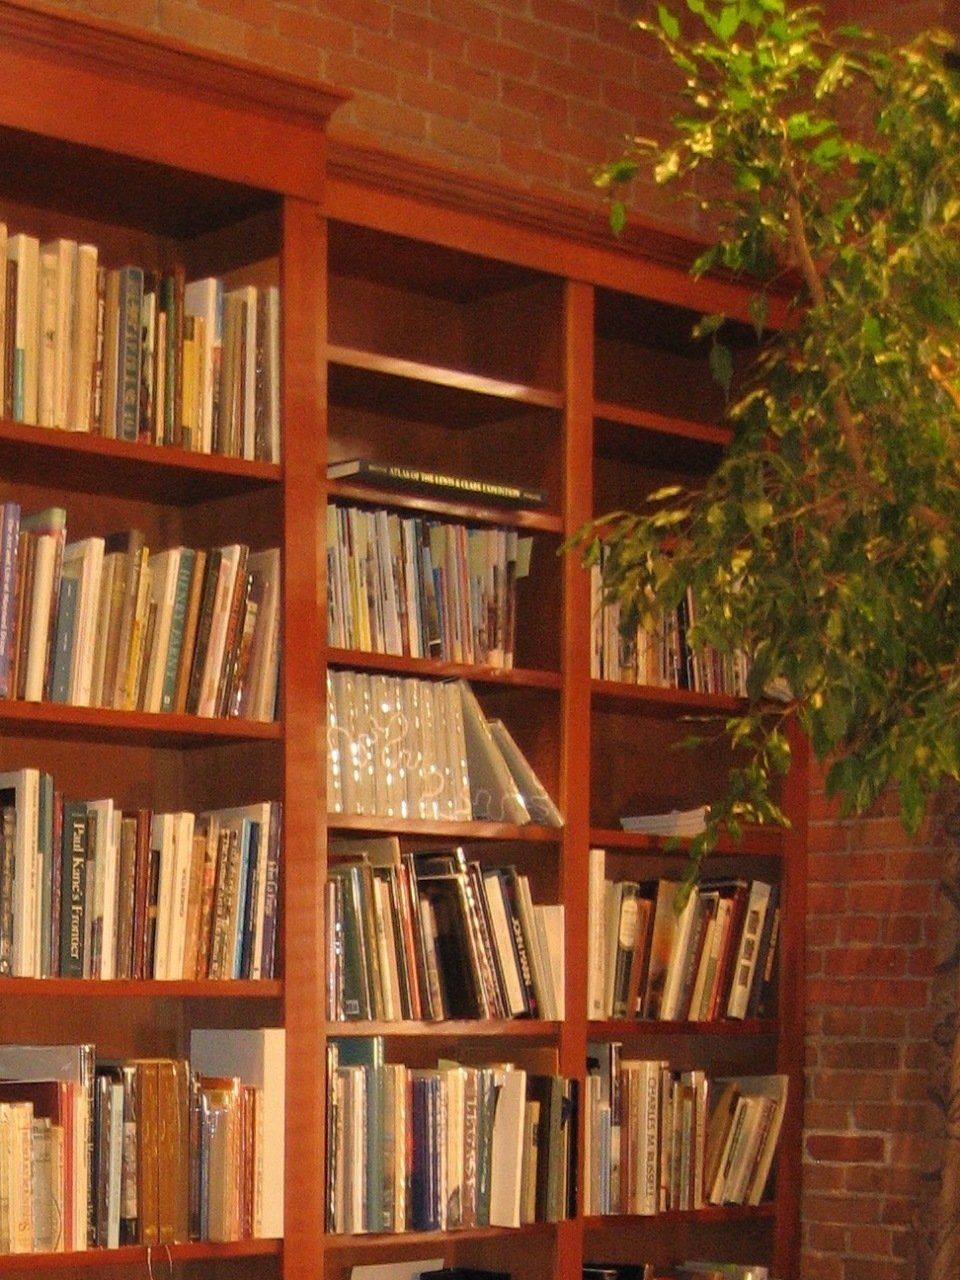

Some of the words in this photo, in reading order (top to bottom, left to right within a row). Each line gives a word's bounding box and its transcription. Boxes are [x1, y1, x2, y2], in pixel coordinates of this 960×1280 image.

[72, 823, 86, 853] Paul
[71, 856, 85, 901] Kane's
[70, 905, 83, 960] Frontier
[510, 917, 524, 949] JOHN
[646, 1077, 657, 1131] CHARLES
